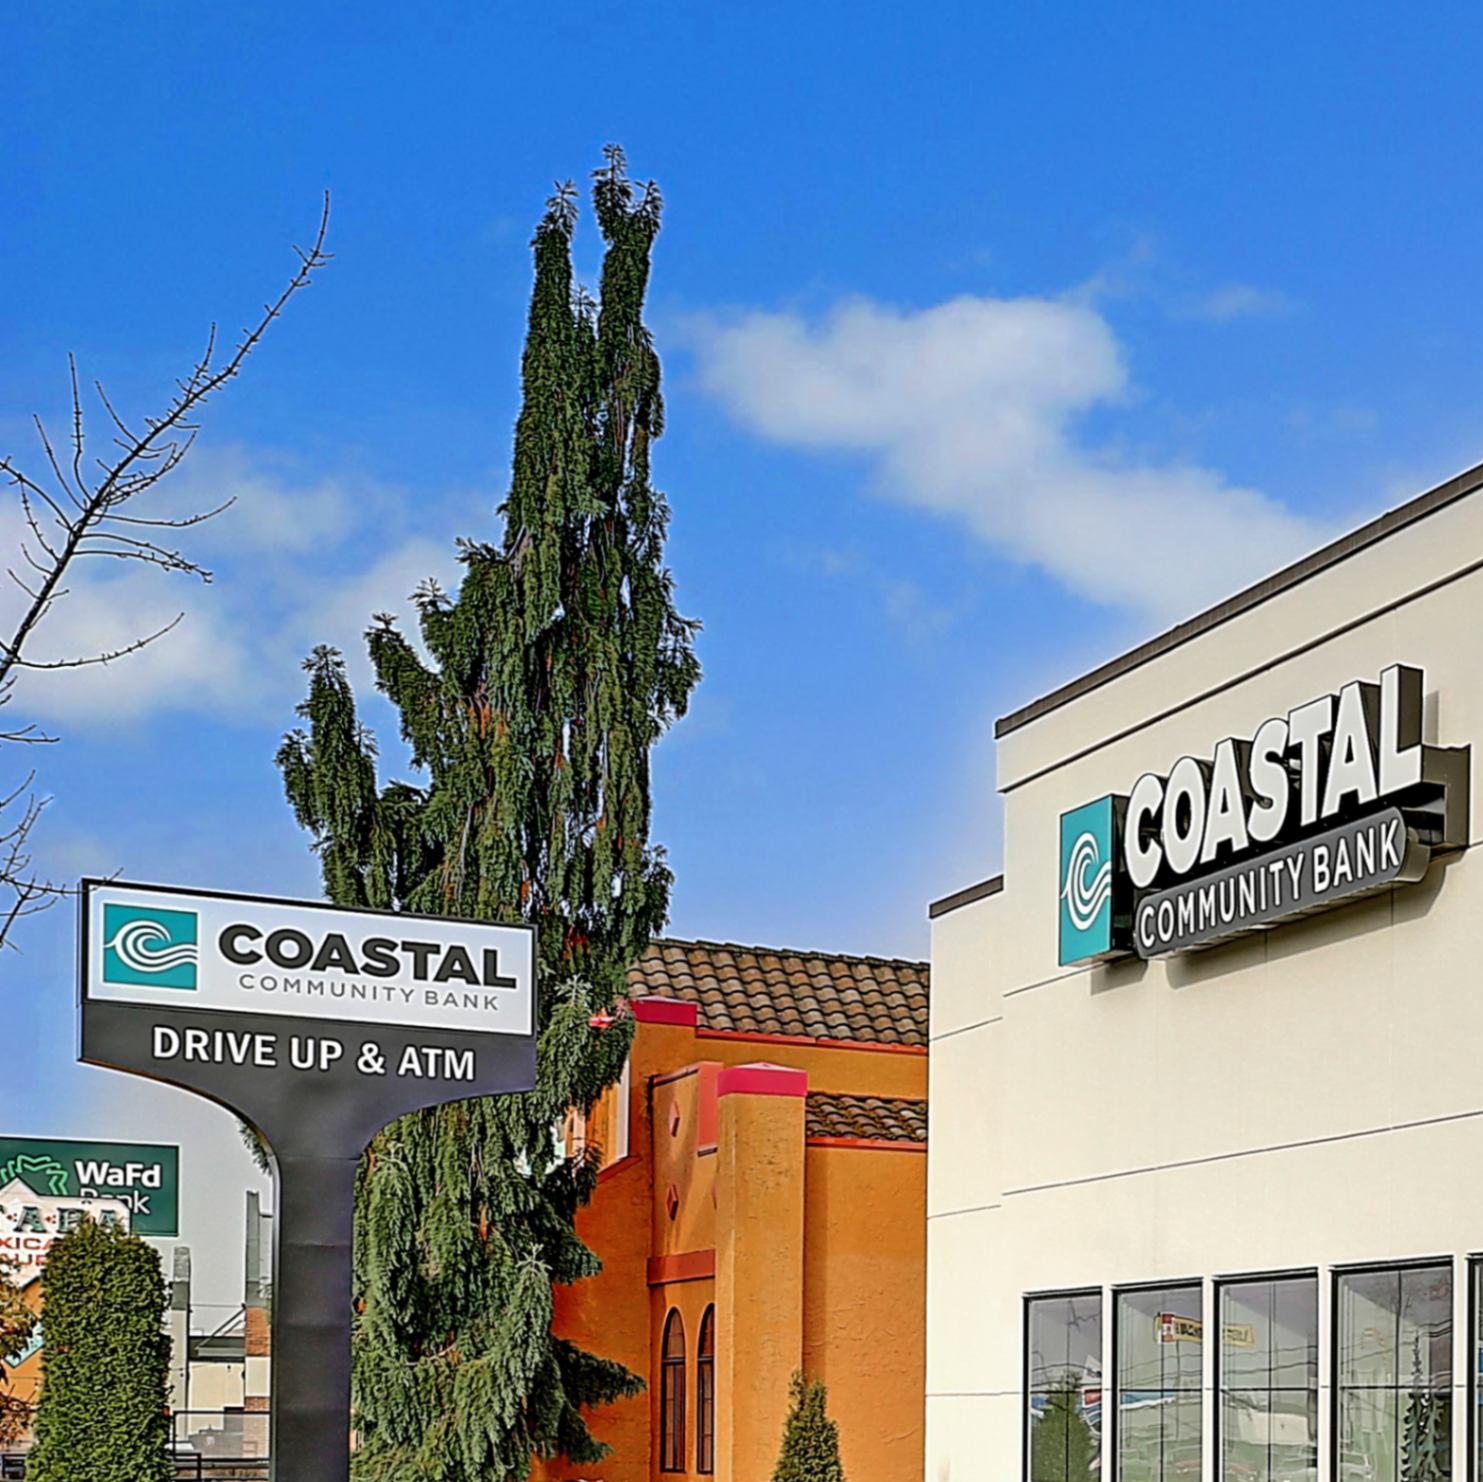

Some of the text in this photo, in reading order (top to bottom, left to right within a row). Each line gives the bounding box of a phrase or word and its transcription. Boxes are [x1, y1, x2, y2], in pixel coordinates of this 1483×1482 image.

[1125, 664, 1423, 888] COASTAL
[1139, 819, 1400, 947] COMMUNITY BANK
[219, 924, 517, 989] COASTAL
[240, 974, 499, 1011] COMMUNITY BANK
[153, 1026, 475, 1080] DRIVE UP & ATM
[75, 1160, 161, 1188] WaFd
